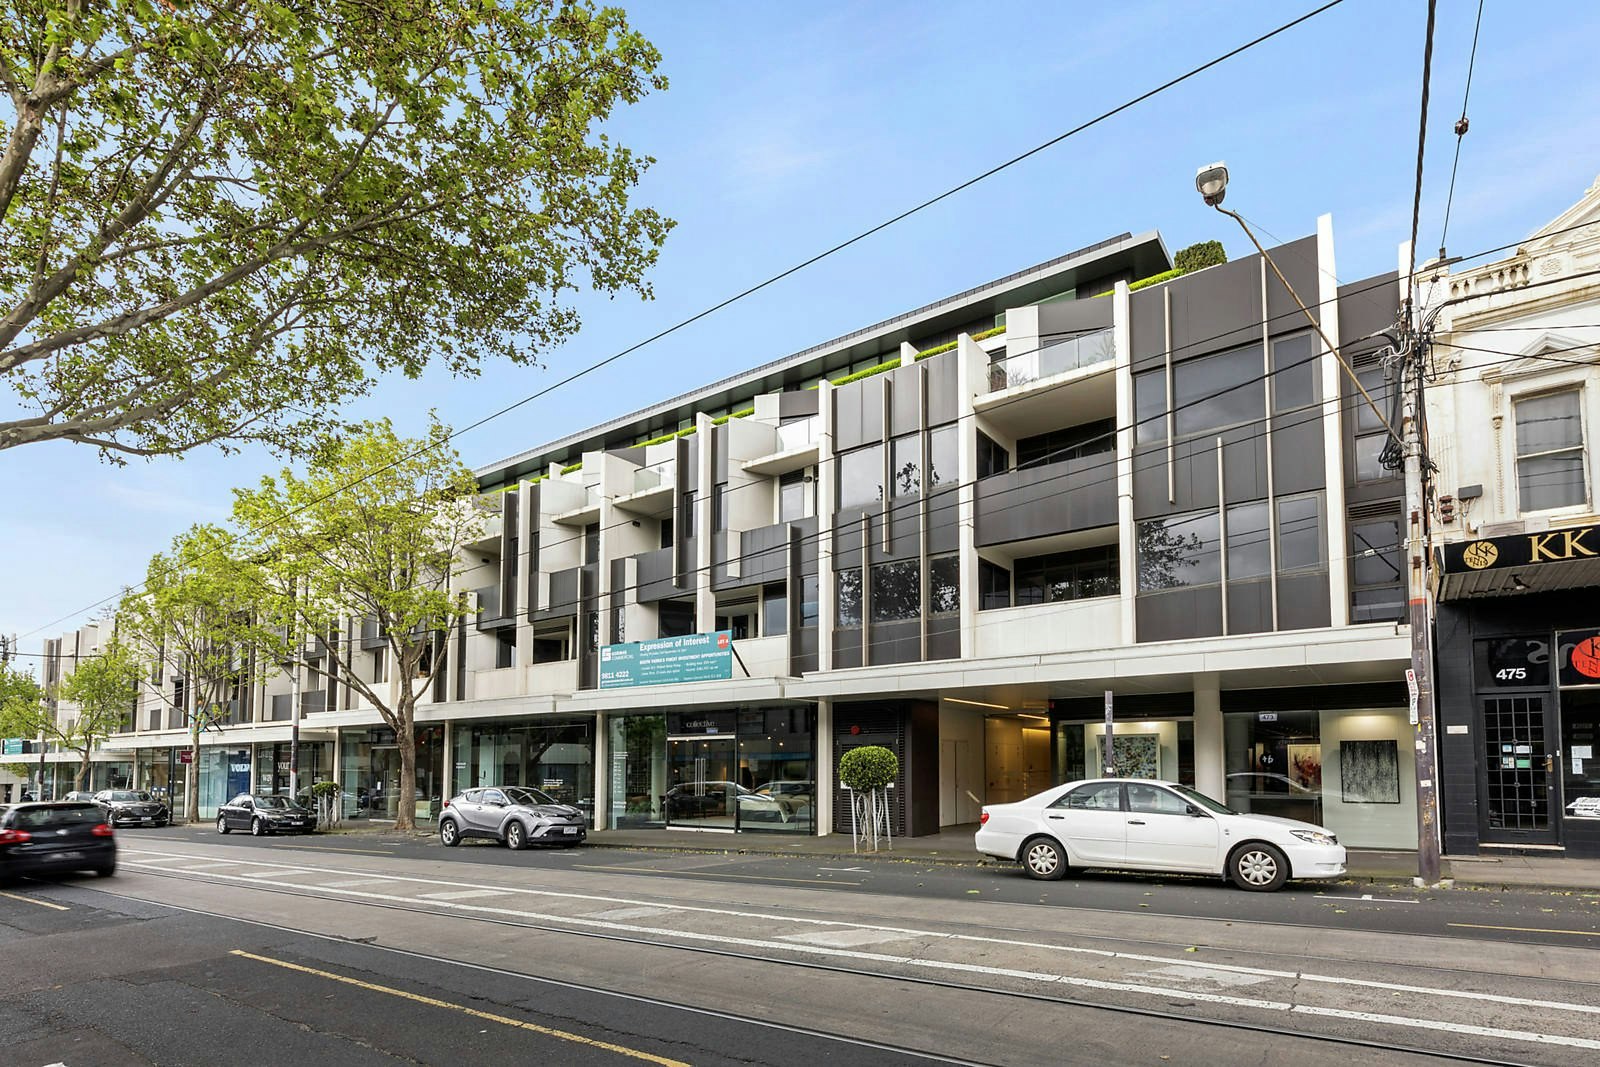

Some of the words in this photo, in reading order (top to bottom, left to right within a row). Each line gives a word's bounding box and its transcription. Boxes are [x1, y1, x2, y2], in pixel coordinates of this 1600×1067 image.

[1528, 528, 1598, 563] KK
[640, 641, 673, 651] Expression
[675, 639, 682, 647] of
[684, 637, 709, 646] Interest
[1496, 667, 1526, 680] 475
